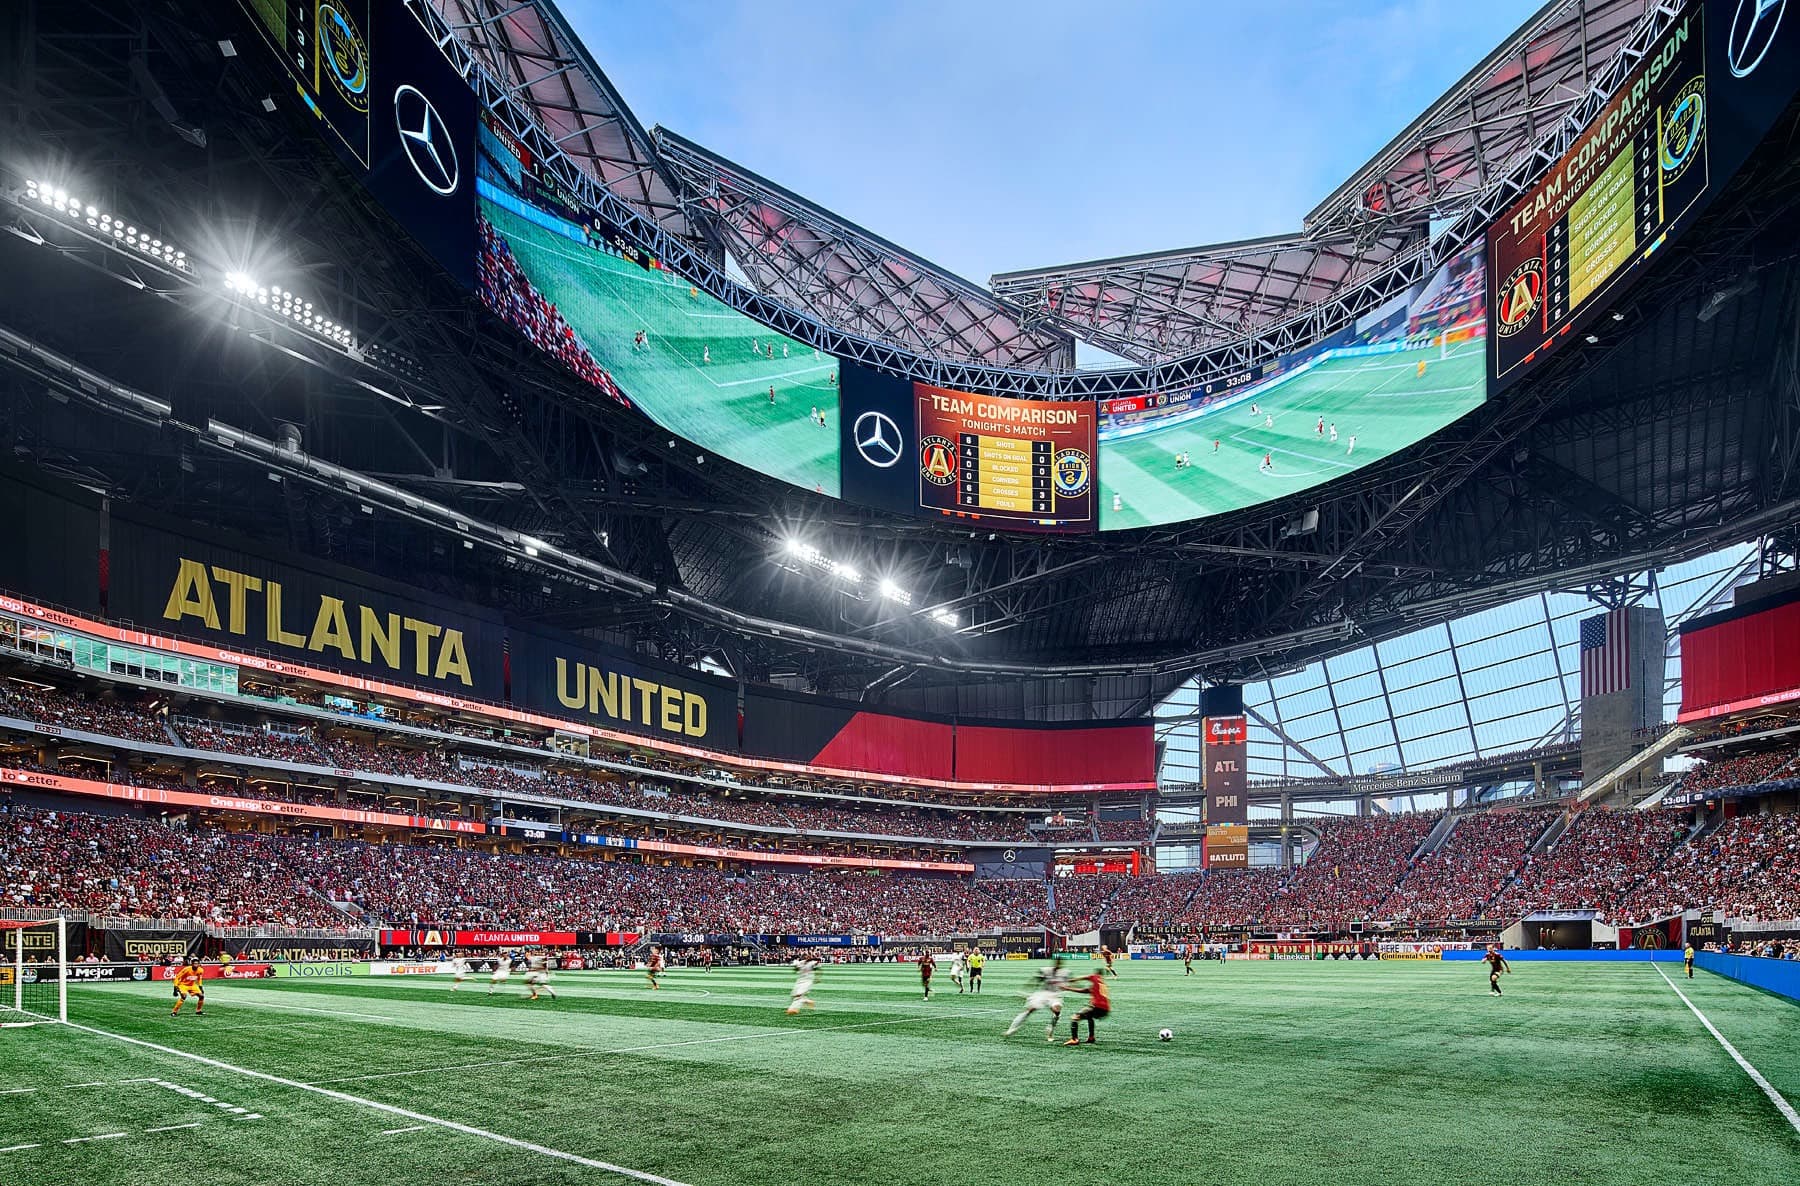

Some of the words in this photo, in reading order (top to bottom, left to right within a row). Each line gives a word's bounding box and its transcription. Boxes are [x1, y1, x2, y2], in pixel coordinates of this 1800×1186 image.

[1511, 181, 1561, 235] TEAM
[1566, 17, 1690, 183] COMPARISON
[493, 125, 521, 159] UNITED
[1547, 161, 1606, 219] TONIGHT'S
[1609, 102, 1650, 160] MATCH
[533, 163, 539, 176] 1
[1588, 171, 1613, 200] SHOTS
[556, 188, 580, 216] UNION
[594, 218, 601, 230] 0
[1584, 203, 1618, 241] BLOCKED
[1584, 220, 1618, 258] CORNERS
[1585, 239, 1618, 274] CROSSES
[1589, 261, 1614, 288] FOULS
[1226, 373, 1252, 388] 33:08
[1205, 385, 1212, 394] 0
[1147, 398, 1153, 407] 1
[1169, 394, 1192, 404] UNION
[931, 394, 974, 416] TEAM
[977, 405, 1078, 425] COMPARISON
[1112, 404, 1137, 412] UNITED
[961, 418, 1011, 434] TONIGHT'S
[1012, 425, 1046, 437] MATCH
[929, 447, 950, 476] A
[163, 557, 473, 687] ATLANTA
[556, 657, 707, 737] UNITED
[219, 651, 241, 663] One
[1214, 760, 1239, 773] ATL
[1351, 778, 1419, 792] Mercedes-Benz
[1420, 772, 1461, 785] Stadium
[210, 797, 234, 807] One
[1216, 795, 1238, 807] PHI
[456, 822, 475, 832] ATL
[585, 836, 599, 844] PHI
[1209, 853, 1246, 862] #ATLUTD
[10, 935, 52, 946] UNITE
[473, 934, 510, 943] ATLANTA
[510, 933, 540, 943] UNITED
[588, 933, 593, 943] 1
[682, 934, 705, 943] 33:08
[775, 935, 781, 944] 0
[129, 943, 183, 955] CONQUER
[1381, 944, 1400, 952] HERE
[75, 968, 115, 980] Mejor
[289, 963, 353, 977] Novelis
[390, 966, 438, 975] LOTTERY
